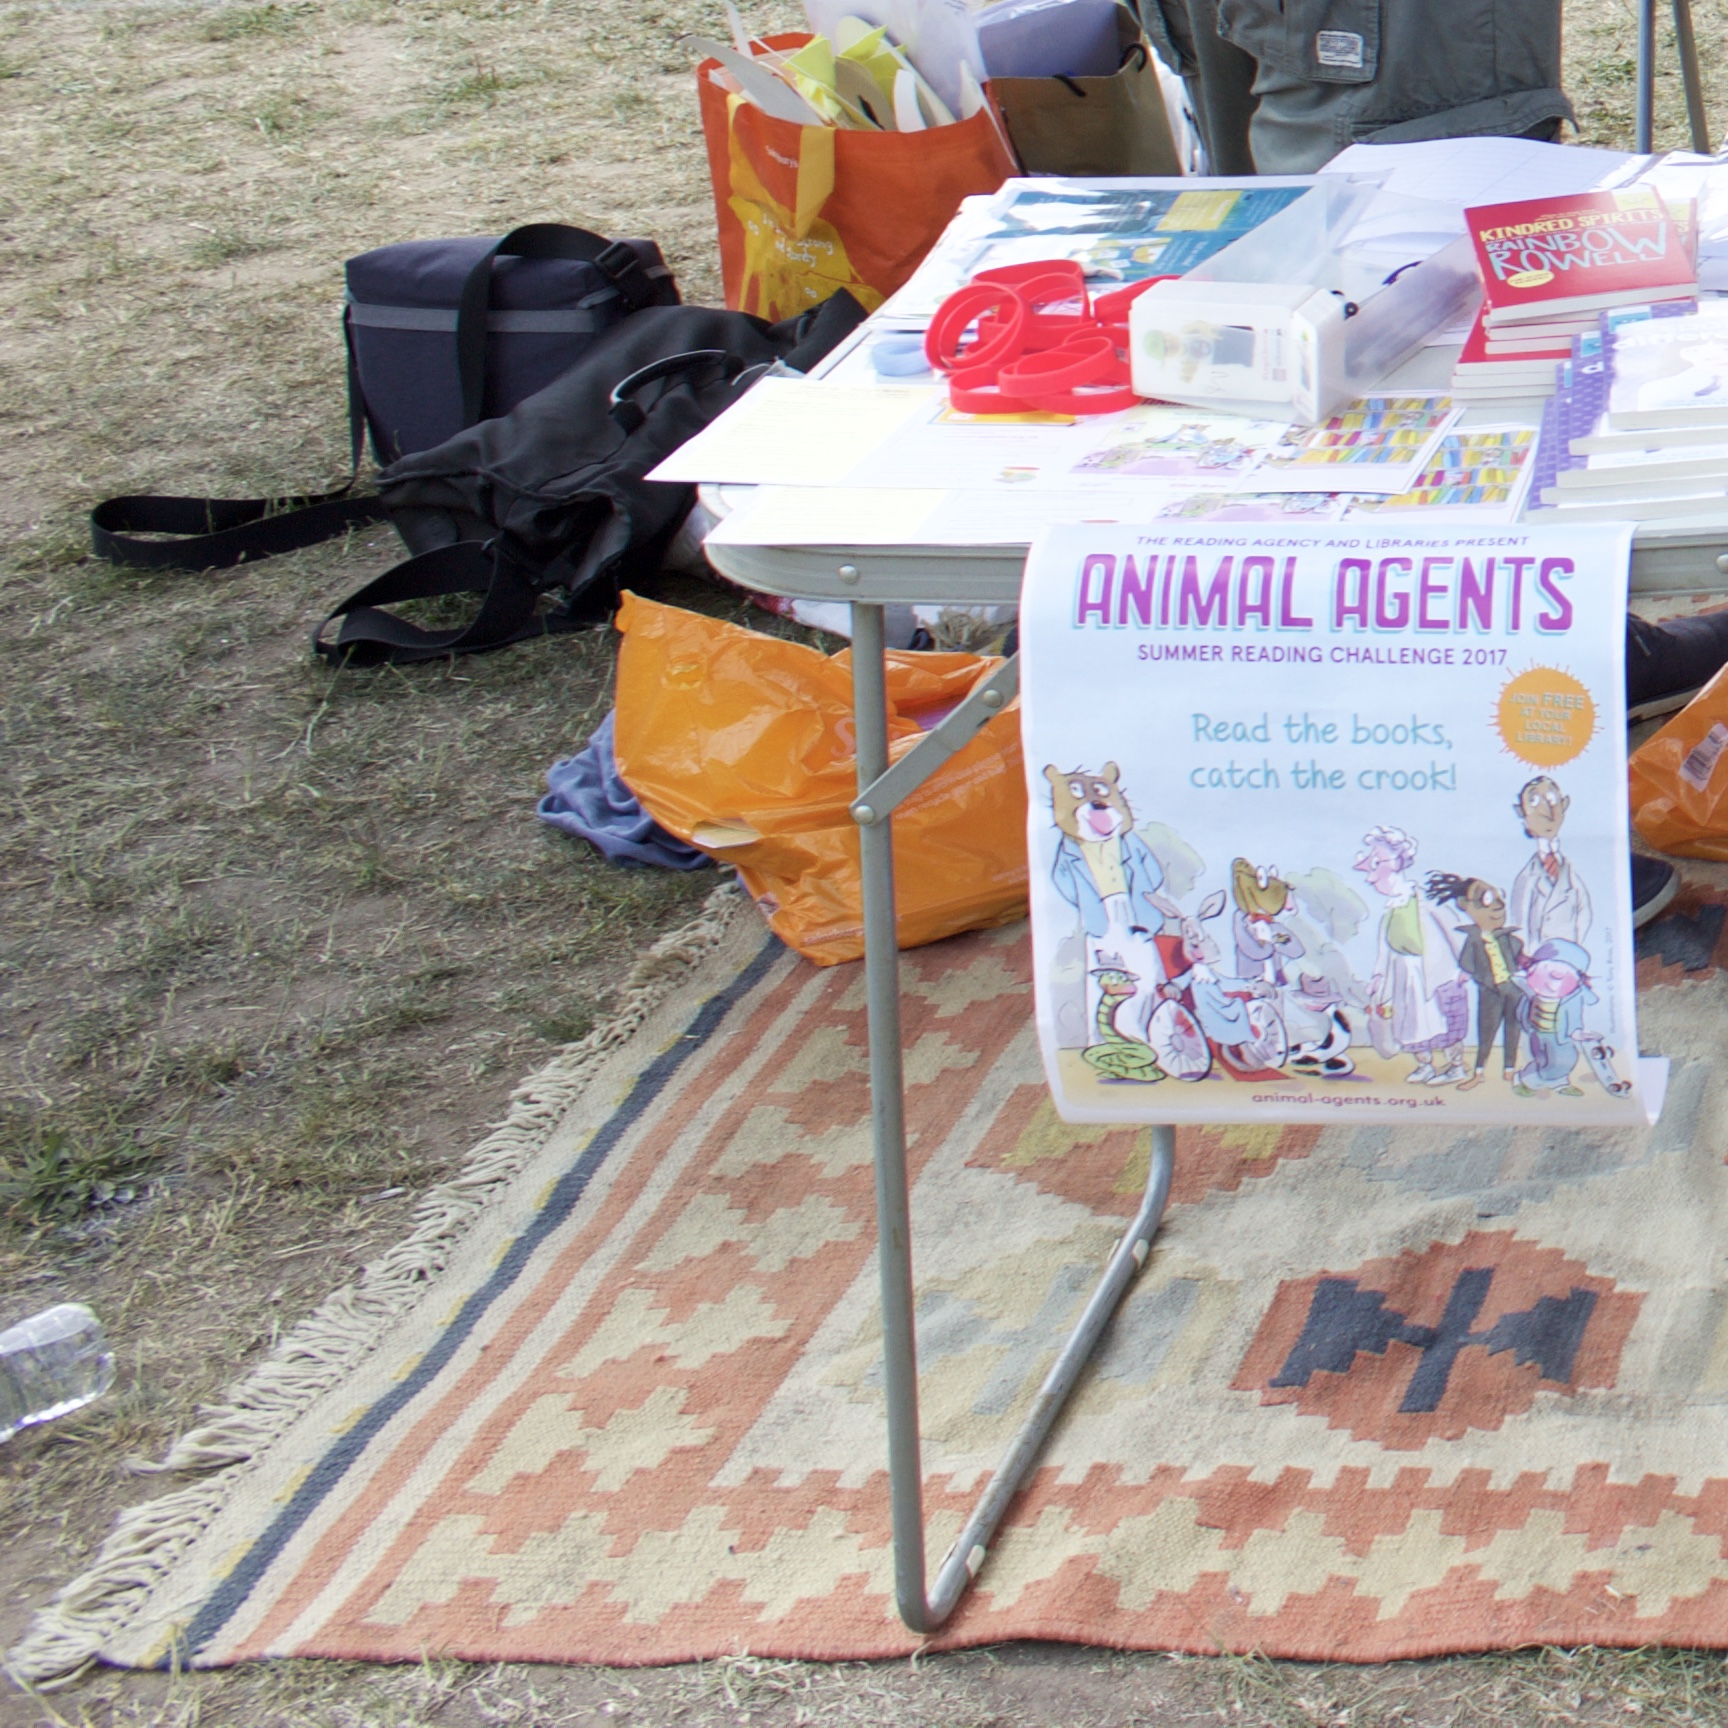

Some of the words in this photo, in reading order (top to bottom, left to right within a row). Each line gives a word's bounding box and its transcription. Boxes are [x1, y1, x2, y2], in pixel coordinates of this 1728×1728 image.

[1480, 218, 1575, 243] KINDRED
[1577, 208, 1666, 229] SPIRITS
[1485, 222, 1668, 256] RAINBOW
[1488, 249, 1667, 281] ROWELL
[1136, 535, 1168, 547] THE
[1173, 535, 1248, 548] READING
[1252, 536, 1323, 548] AGENCY
[1325, 537, 1361, 548] AND
[1365, 537, 1450, 549] LIBRARIES
[1454, 535, 1531, 548] PRESENT
[1074, 553, 1315, 631] ANIMAL
[1332, 555, 1576, 633] AGENTS
[1136, 643, 1224, 662] SUMMER
[1230, 644, 1324, 664] READING
[1329, 646, 1456, 666] CHALLENGE
[1461, 647, 1508, 667] 2017
[1510, 692, 1539, 705] JOIN
[1541, 691, 1585, 710] FREE
[1520, 706, 1535, 717] AT
[1537, 708, 1573, 721] YOUR
[1190, 712, 1270, 744] Read
[1283, 712, 1339, 745] the
[1351, 713, 1455, 751] books,
[1524, 719, 1565, 734] LOCAL
[1188, 760, 1281, 791] catch
[1290, 760, 1347, 791] the
[1357, 761, 1458, 792] crook!
[1251, 1092, 1447, 1109] animal-agents.org.uk
